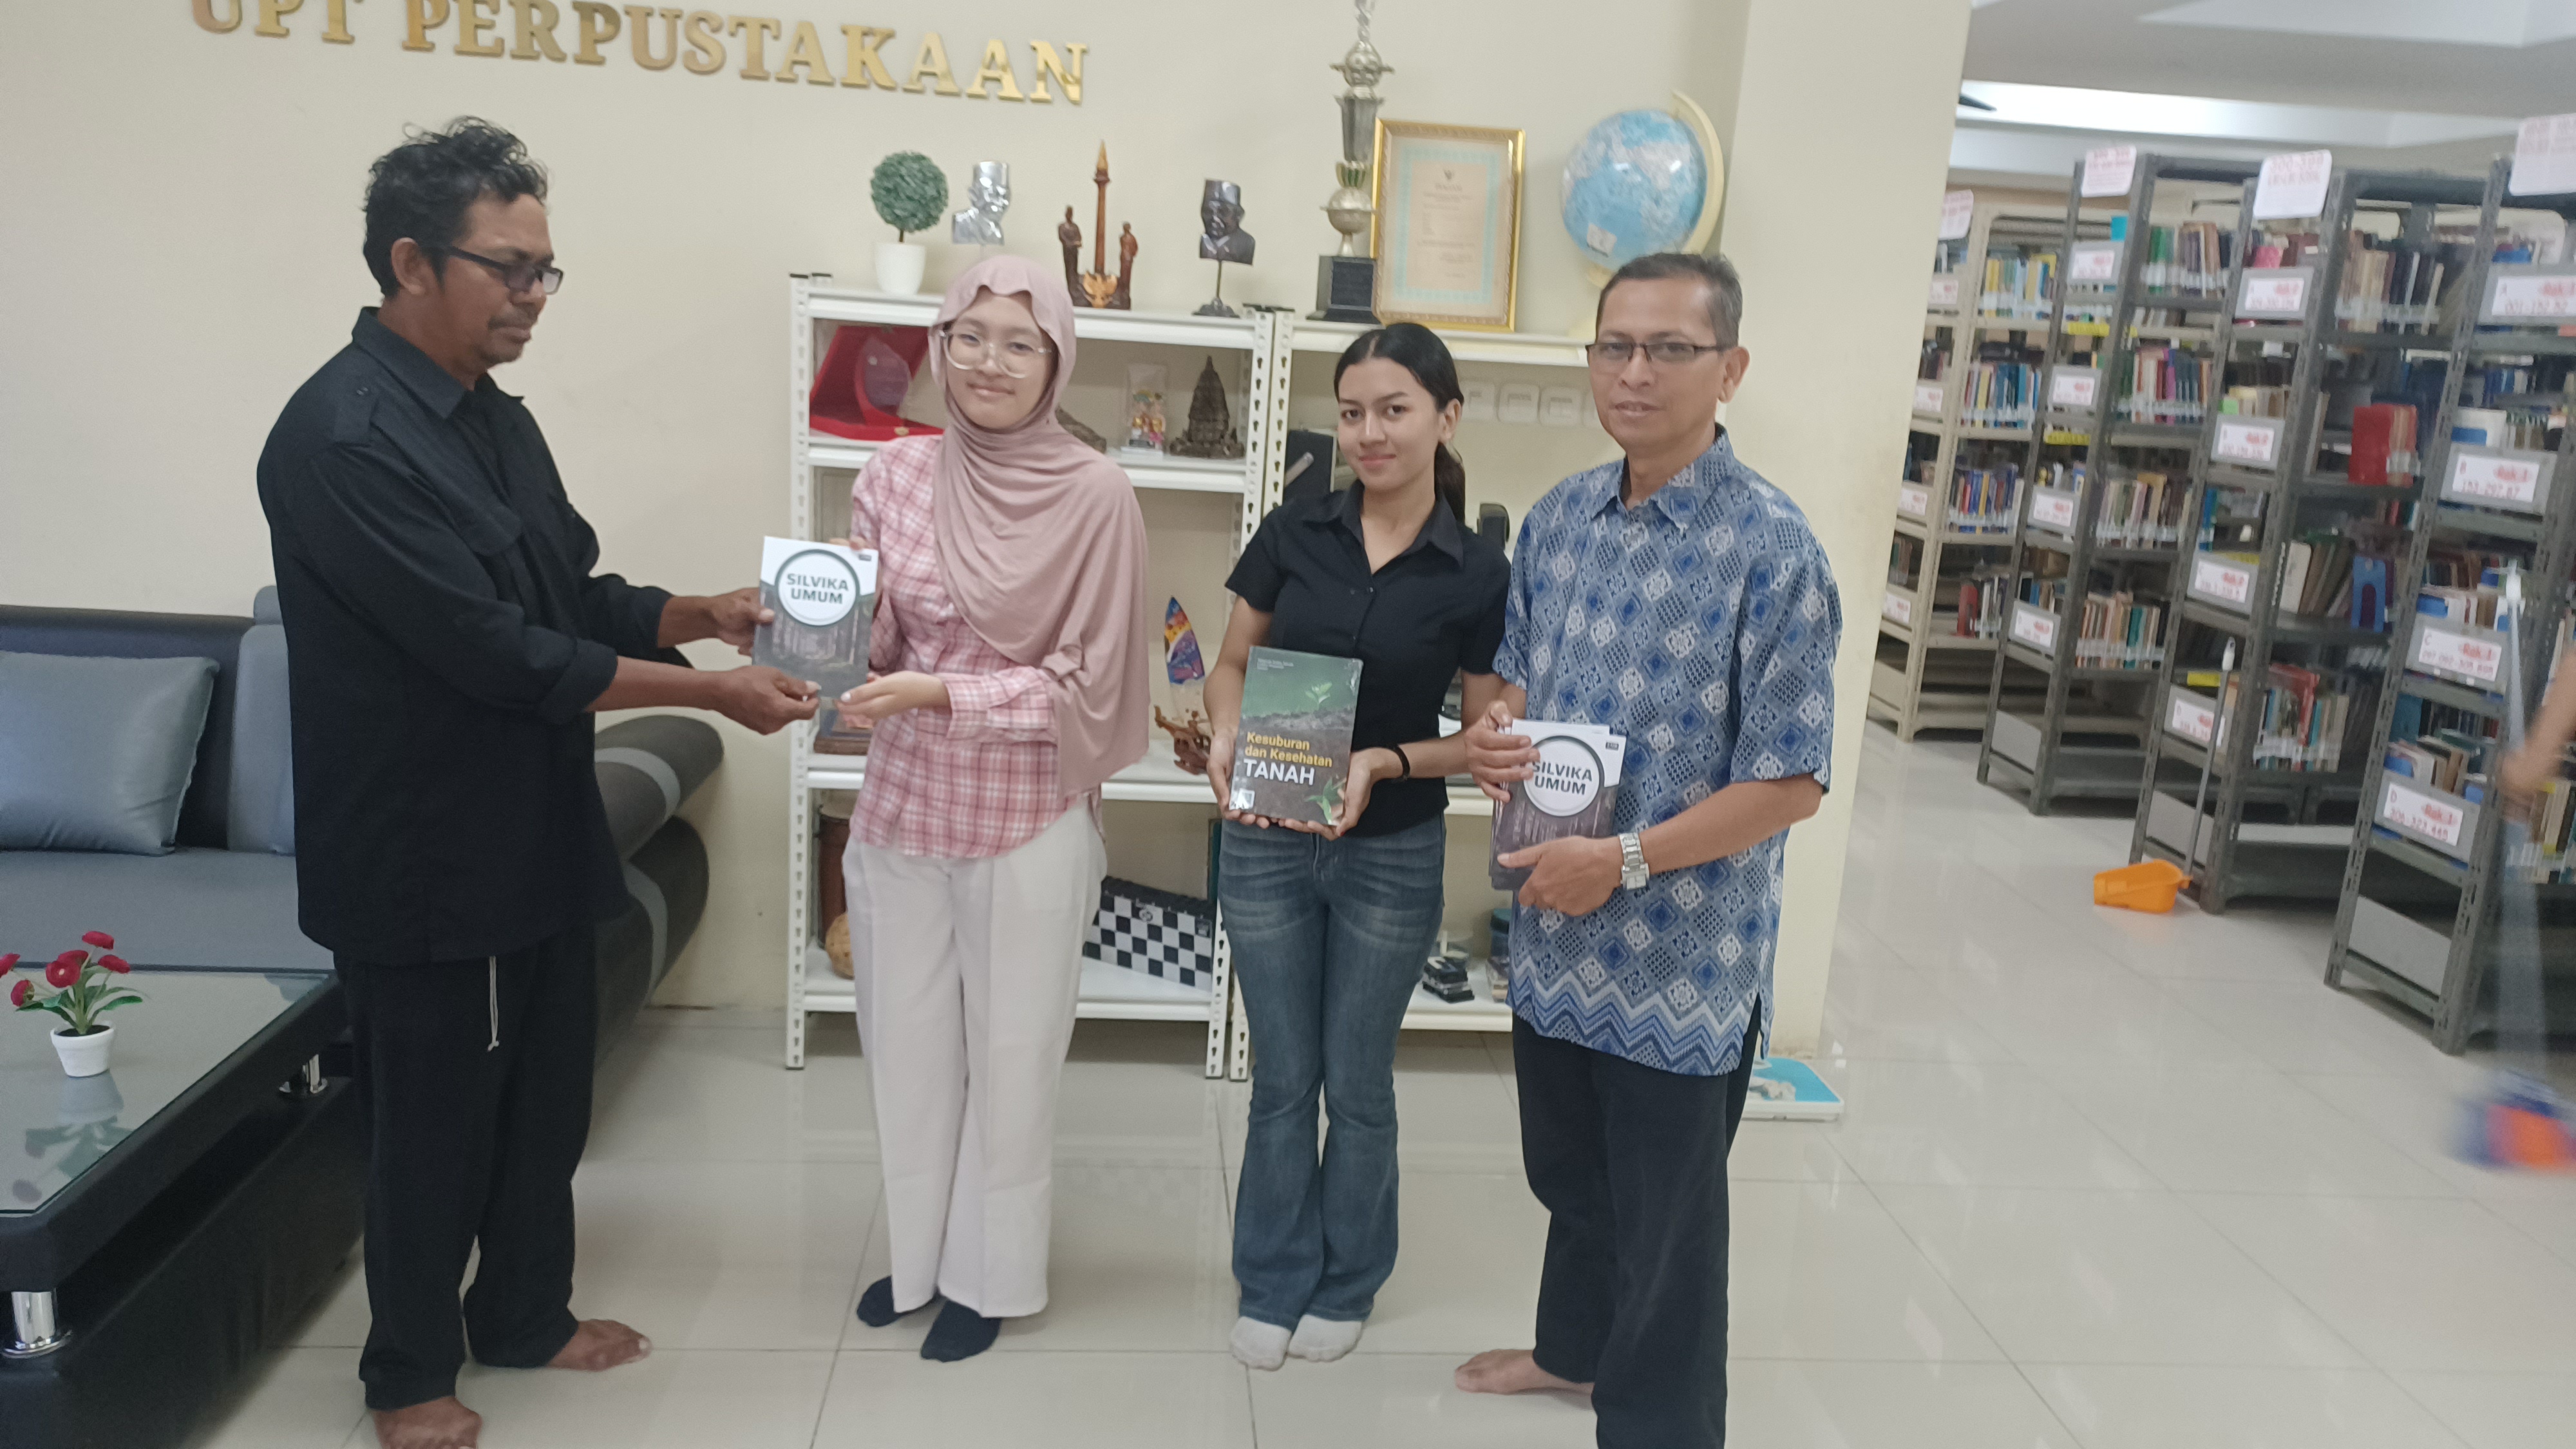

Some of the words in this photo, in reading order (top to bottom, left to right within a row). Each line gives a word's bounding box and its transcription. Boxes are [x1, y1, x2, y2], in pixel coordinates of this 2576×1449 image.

[401, 0, 1088, 105] PERPUSTAKAAN
[786, 573, 849, 592] SILVIKA
[790, 588, 844, 605] UMUM
[1246, 732, 1310, 751] Kesuburan
[1244, 744, 1267, 758] dan
[1270, 748, 1332, 768] Kesehatan
[1243, 758, 1315, 786] TANAH
[1532, 761, 1593, 782] SILVIKA
[1535, 775, 1586, 795] UMUM
